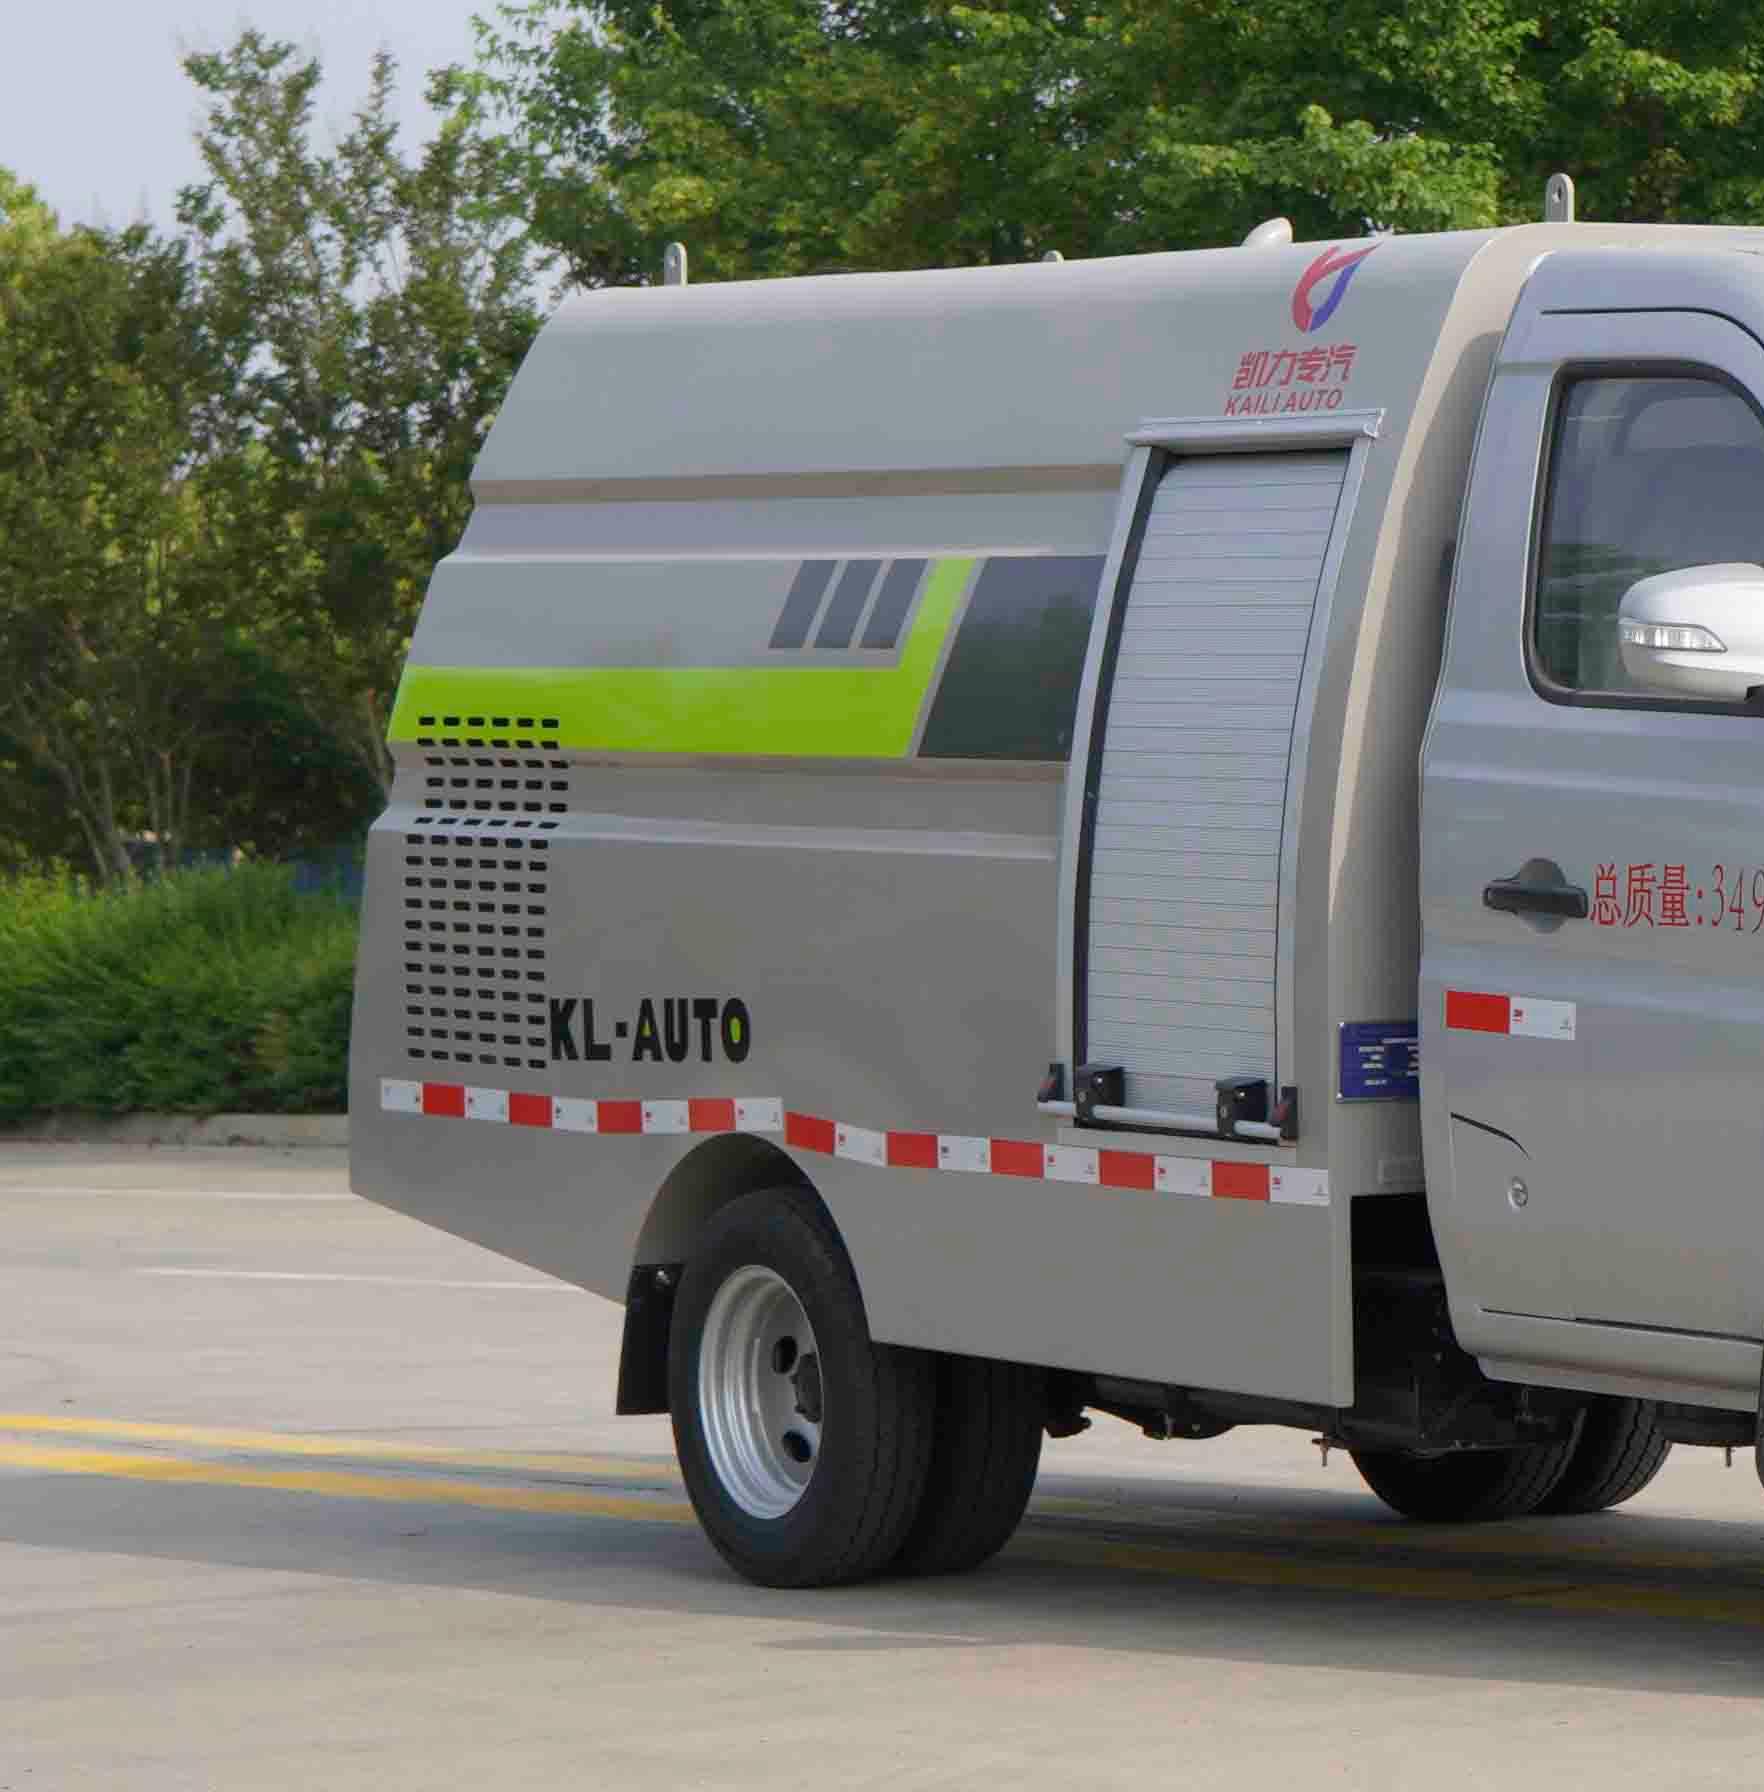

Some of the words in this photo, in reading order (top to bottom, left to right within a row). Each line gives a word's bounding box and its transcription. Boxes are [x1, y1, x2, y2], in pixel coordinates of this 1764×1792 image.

[1232, 345, 1357, 390] 凯力专汽
[1224, 392, 1281, 416] KAILI
[1285, 388, 1343, 411] AUTO
[550, 996, 751, 1064] KL-AUTO
